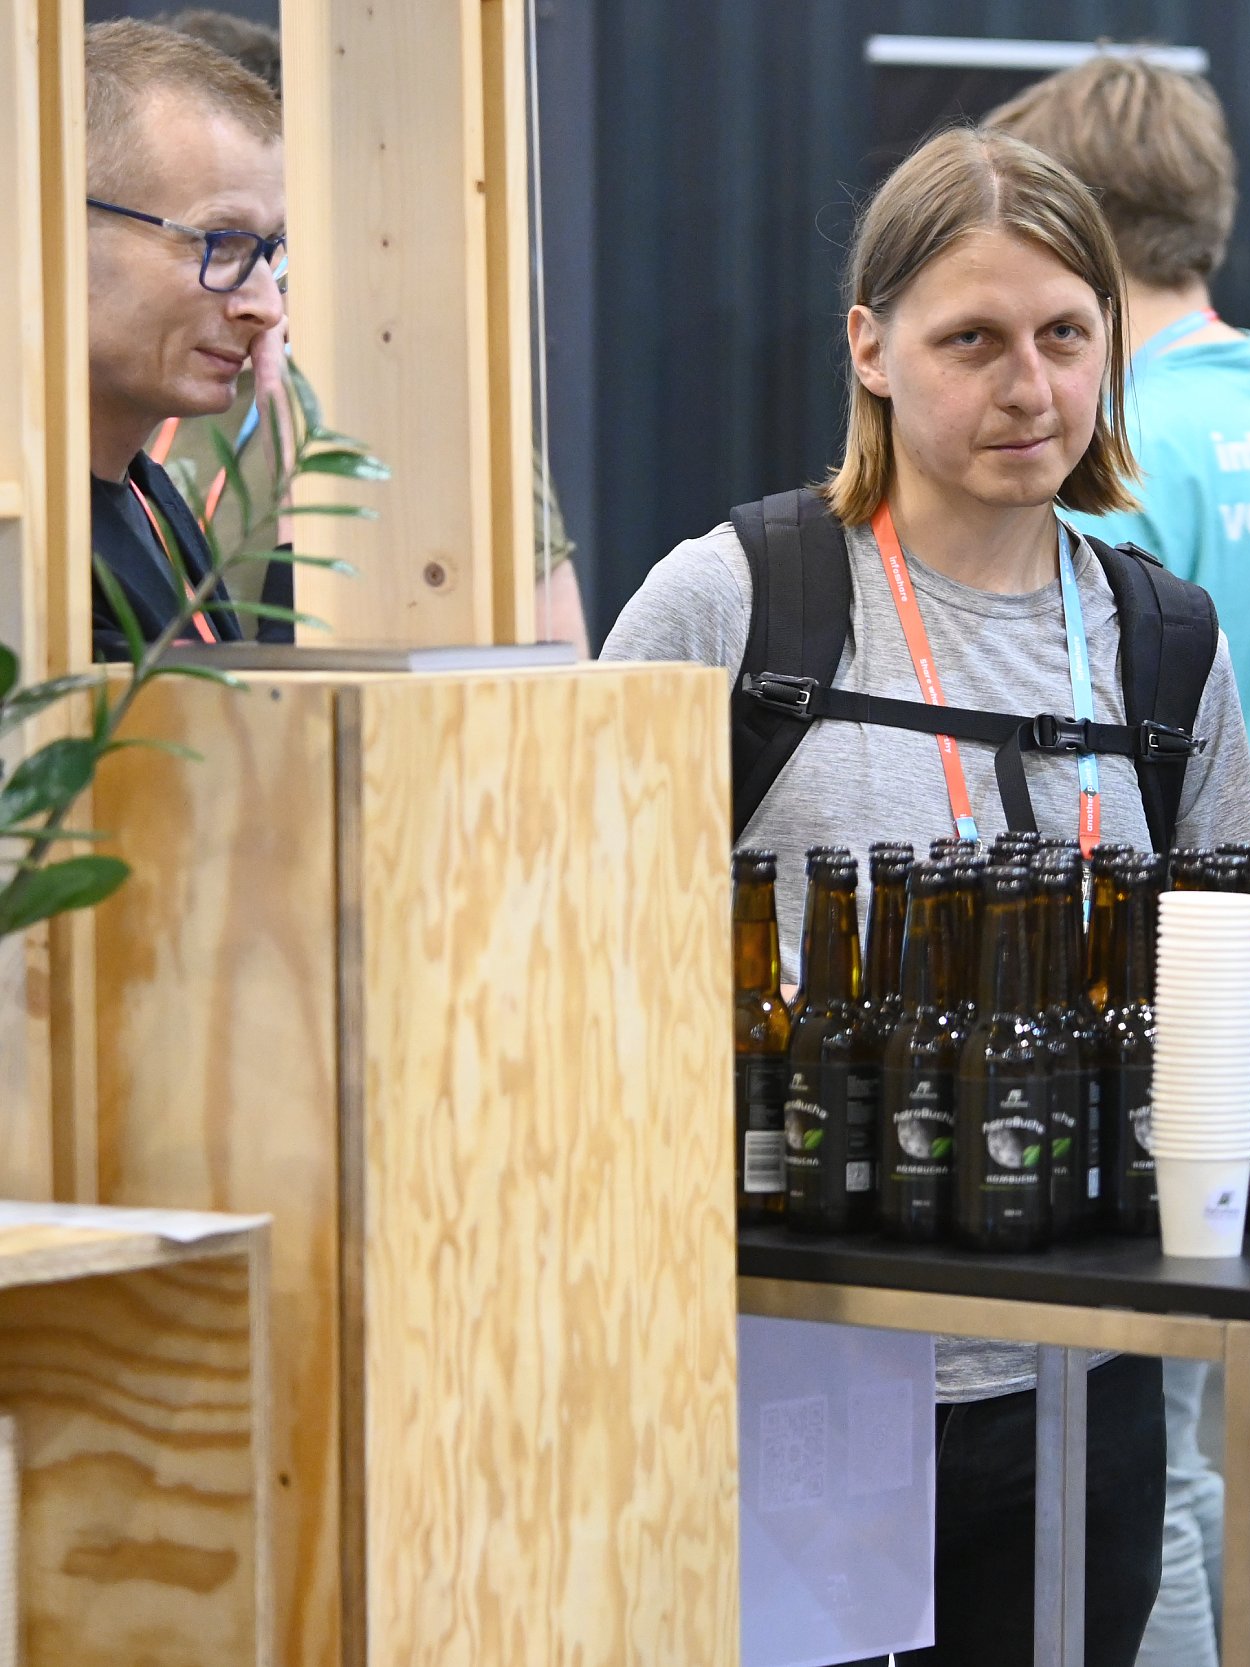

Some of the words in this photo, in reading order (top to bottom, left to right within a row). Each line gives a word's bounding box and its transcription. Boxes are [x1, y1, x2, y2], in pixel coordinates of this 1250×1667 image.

[889, 555, 907, 602] infoshare
[919, 659, 932, 684] Share
[928, 686, 939, 706] wha
[1086, 794, 1094, 832] another
